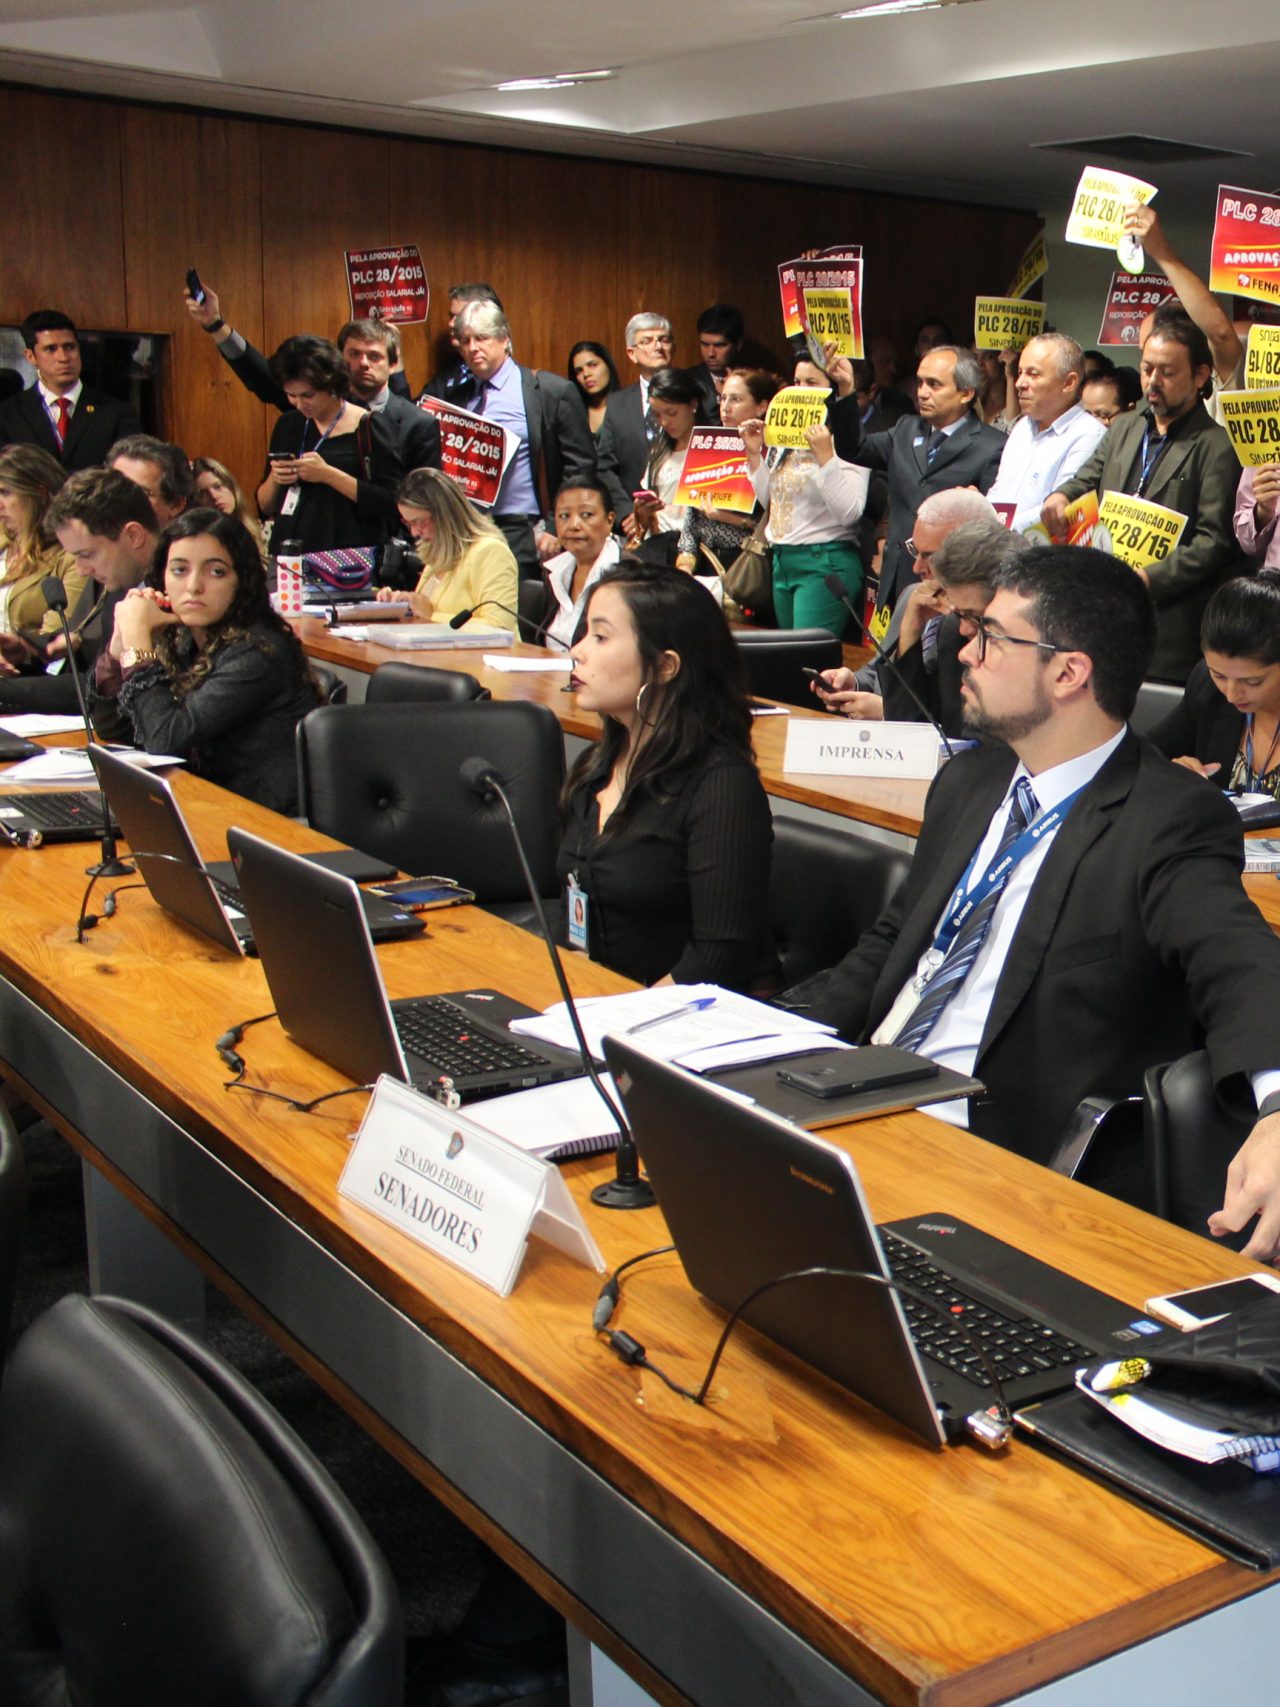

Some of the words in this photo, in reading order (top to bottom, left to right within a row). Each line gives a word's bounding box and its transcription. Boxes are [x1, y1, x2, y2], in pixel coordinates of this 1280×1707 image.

[1076, 193, 1099, 218] PLC
[1098, 198, 1126, 224] 28/1
[1222, 198, 1257, 222] PLC
[352, 270, 373, 284] PLC
[376, 265, 423, 283] 28/2015
[796, 271, 814, 287] PLC
[1117, 276, 1138, 284] PELA
[1112, 291, 1140, 304] PLC
[978, 303, 993, 313] PELA
[994, 303, 1032, 317] APROVAÇÃO
[809, 313, 825, 334] PLC
[826, 312, 851, 335] 28/15
[978, 315, 1000, 332] PLC
[1002, 316, 1040, 337] 28/15
[785, 394, 816, 406] APROVAÇÃO
[1223, 401, 1241, 415] PELA
[443, 414, 490, 434] APROVAÇÃO
[491, 427, 501, 437] DO
[768, 408, 788, 427] PLC
[790, 408, 822, 429] 28/15
[1228, 419, 1255, 444] PLC
[445, 433, 500, 459] 28/2015
[691, 435, 713, 450] PLC
[453, 456, 485, 473] SALARIAL
[1102, 501, 1118, 513] PELA
[1117, 505, 1165, 529] APROVAÇÃO
[1165, 520, 1179, 535] DO
[1116, 523, 1171, 561] 28/15
[819, 745, 905, 761] IMPRENSA
[994, 855, 1013, 876] AIRBUS
[396, 1145, 438, 1178] SENADO
[438, 1168, 485, 1207] FEDERAL
[374, 1172, 483, 1254] SENADORES
